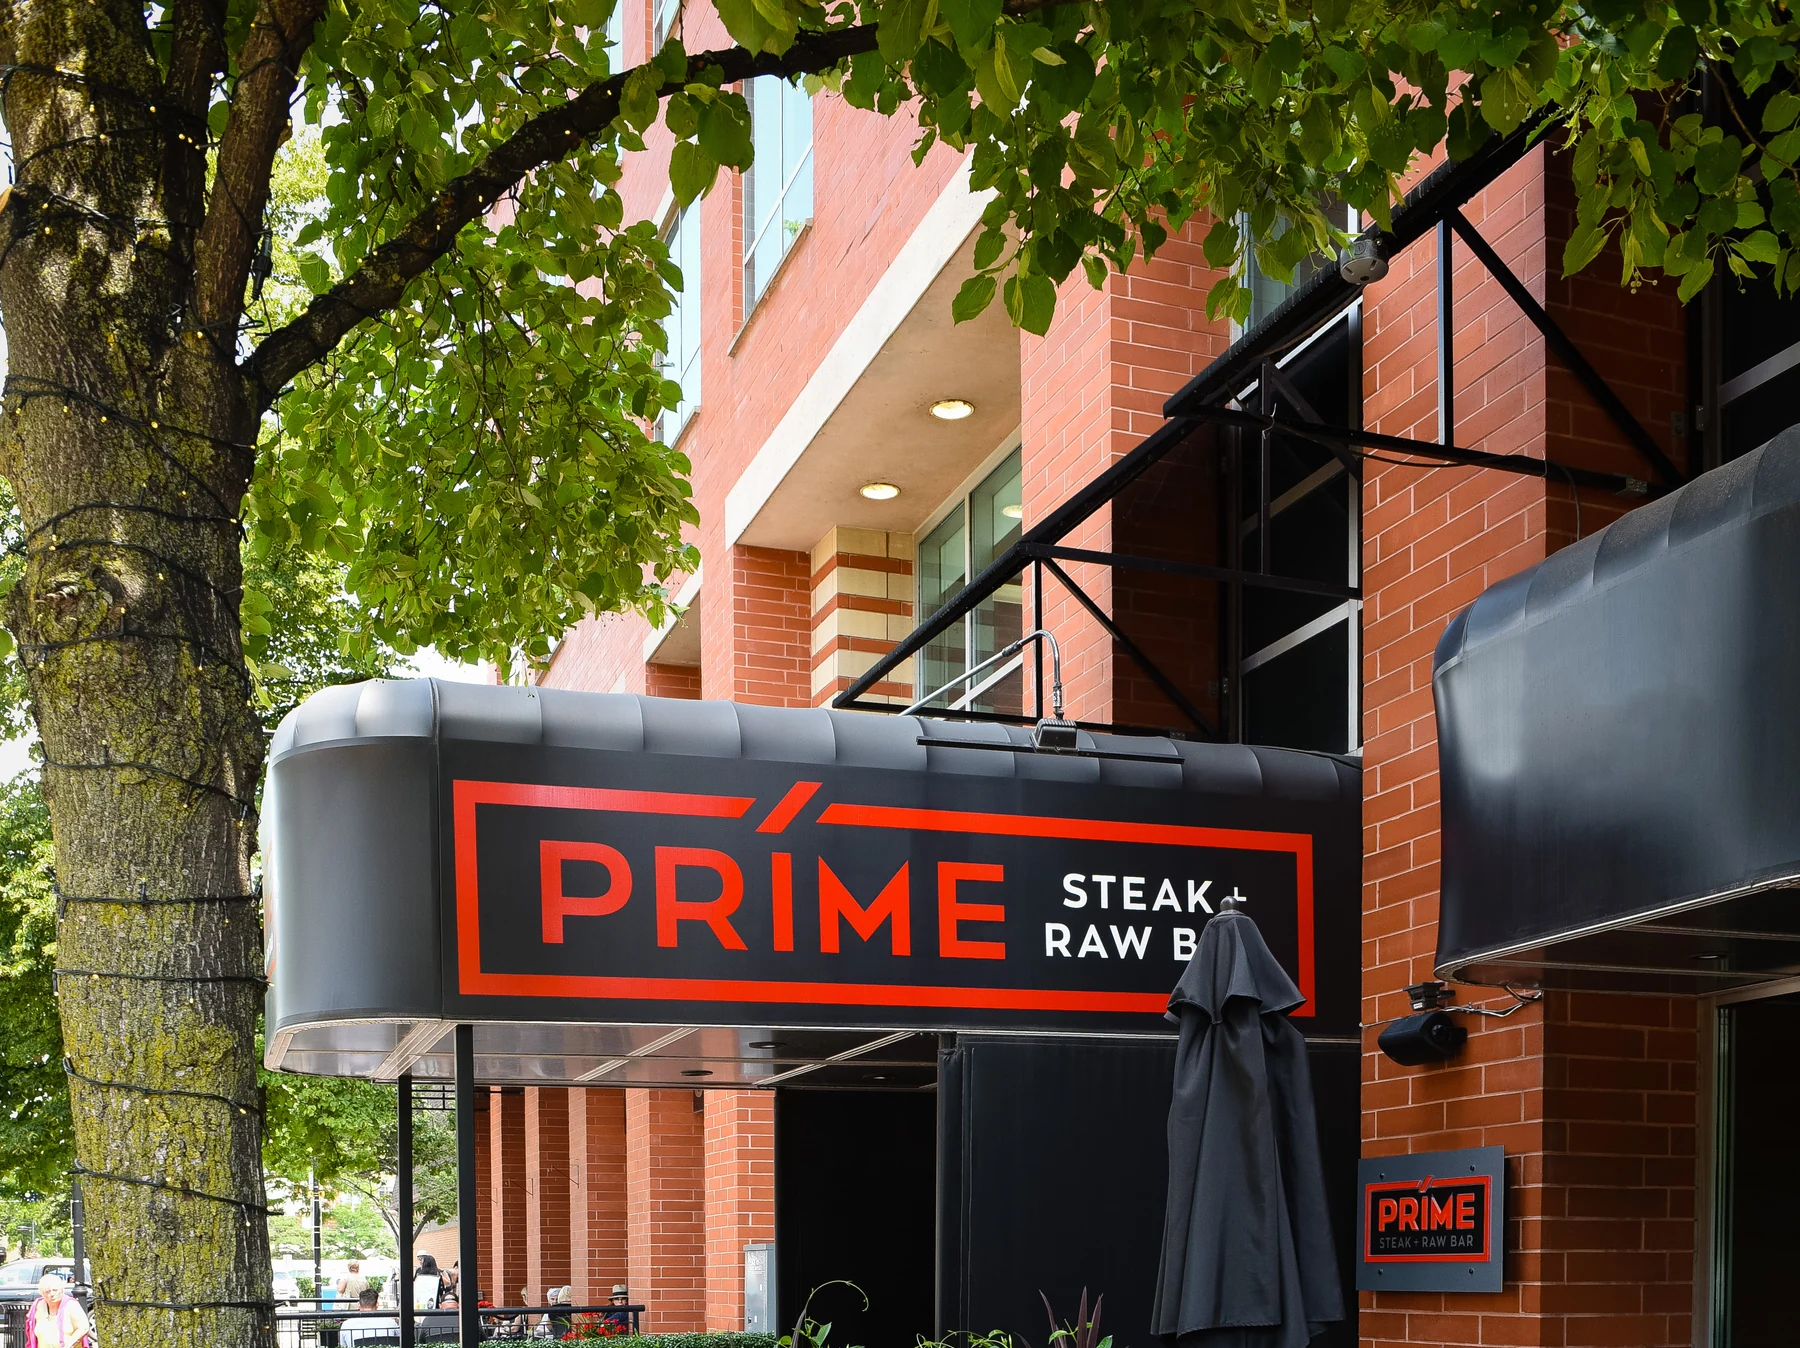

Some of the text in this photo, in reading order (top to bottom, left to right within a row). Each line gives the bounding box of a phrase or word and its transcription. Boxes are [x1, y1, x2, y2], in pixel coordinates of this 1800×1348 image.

[1062, 873, 1214, 914] STEAK
[1045, 922, 1152, 960] RAW
[1379, 1237, 1412, 1249] STEAK
[1421, 1236, 1447, 1248] RAW
[1450, 1235, 1474, 1247] BAR
